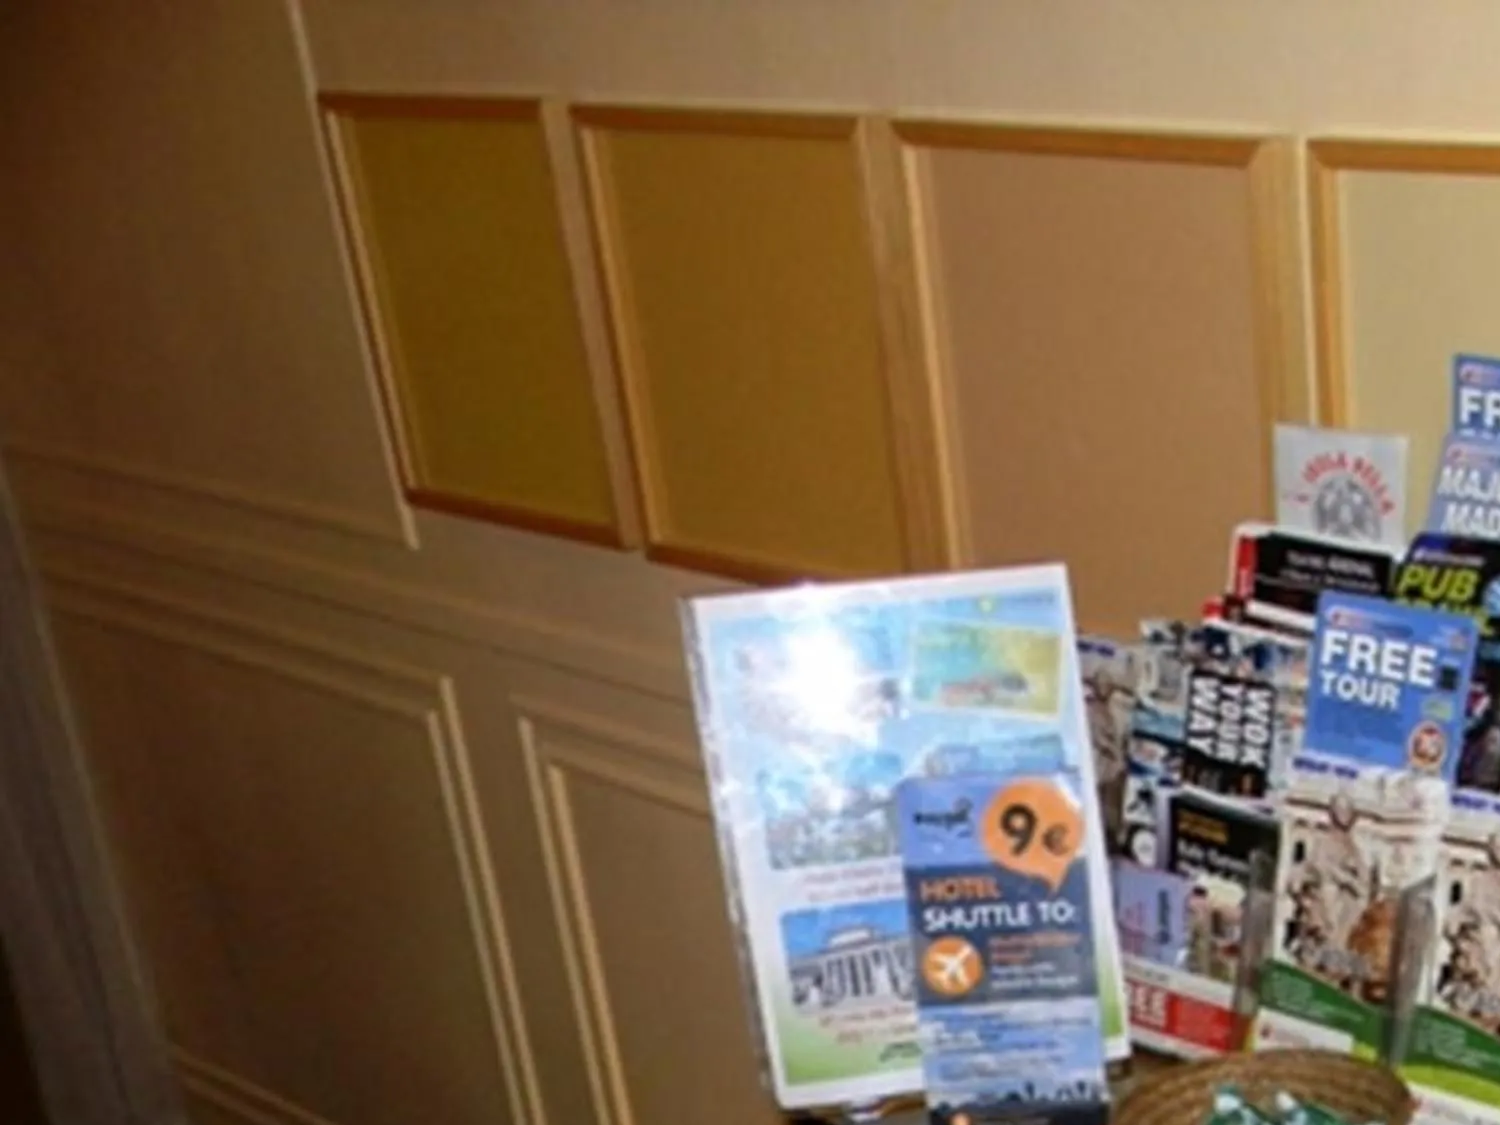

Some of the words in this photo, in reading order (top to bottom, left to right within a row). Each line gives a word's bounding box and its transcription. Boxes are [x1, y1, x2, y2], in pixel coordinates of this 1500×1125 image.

[1399, 565, 1479, 600] PUB
[1319, 630, 1438, 688] FREE
[1318, 669, 1400, 709] TOUR
[920, 875, 1001, 902] HOTEL
[922, 901, 1032, 933] SHUTTLE
